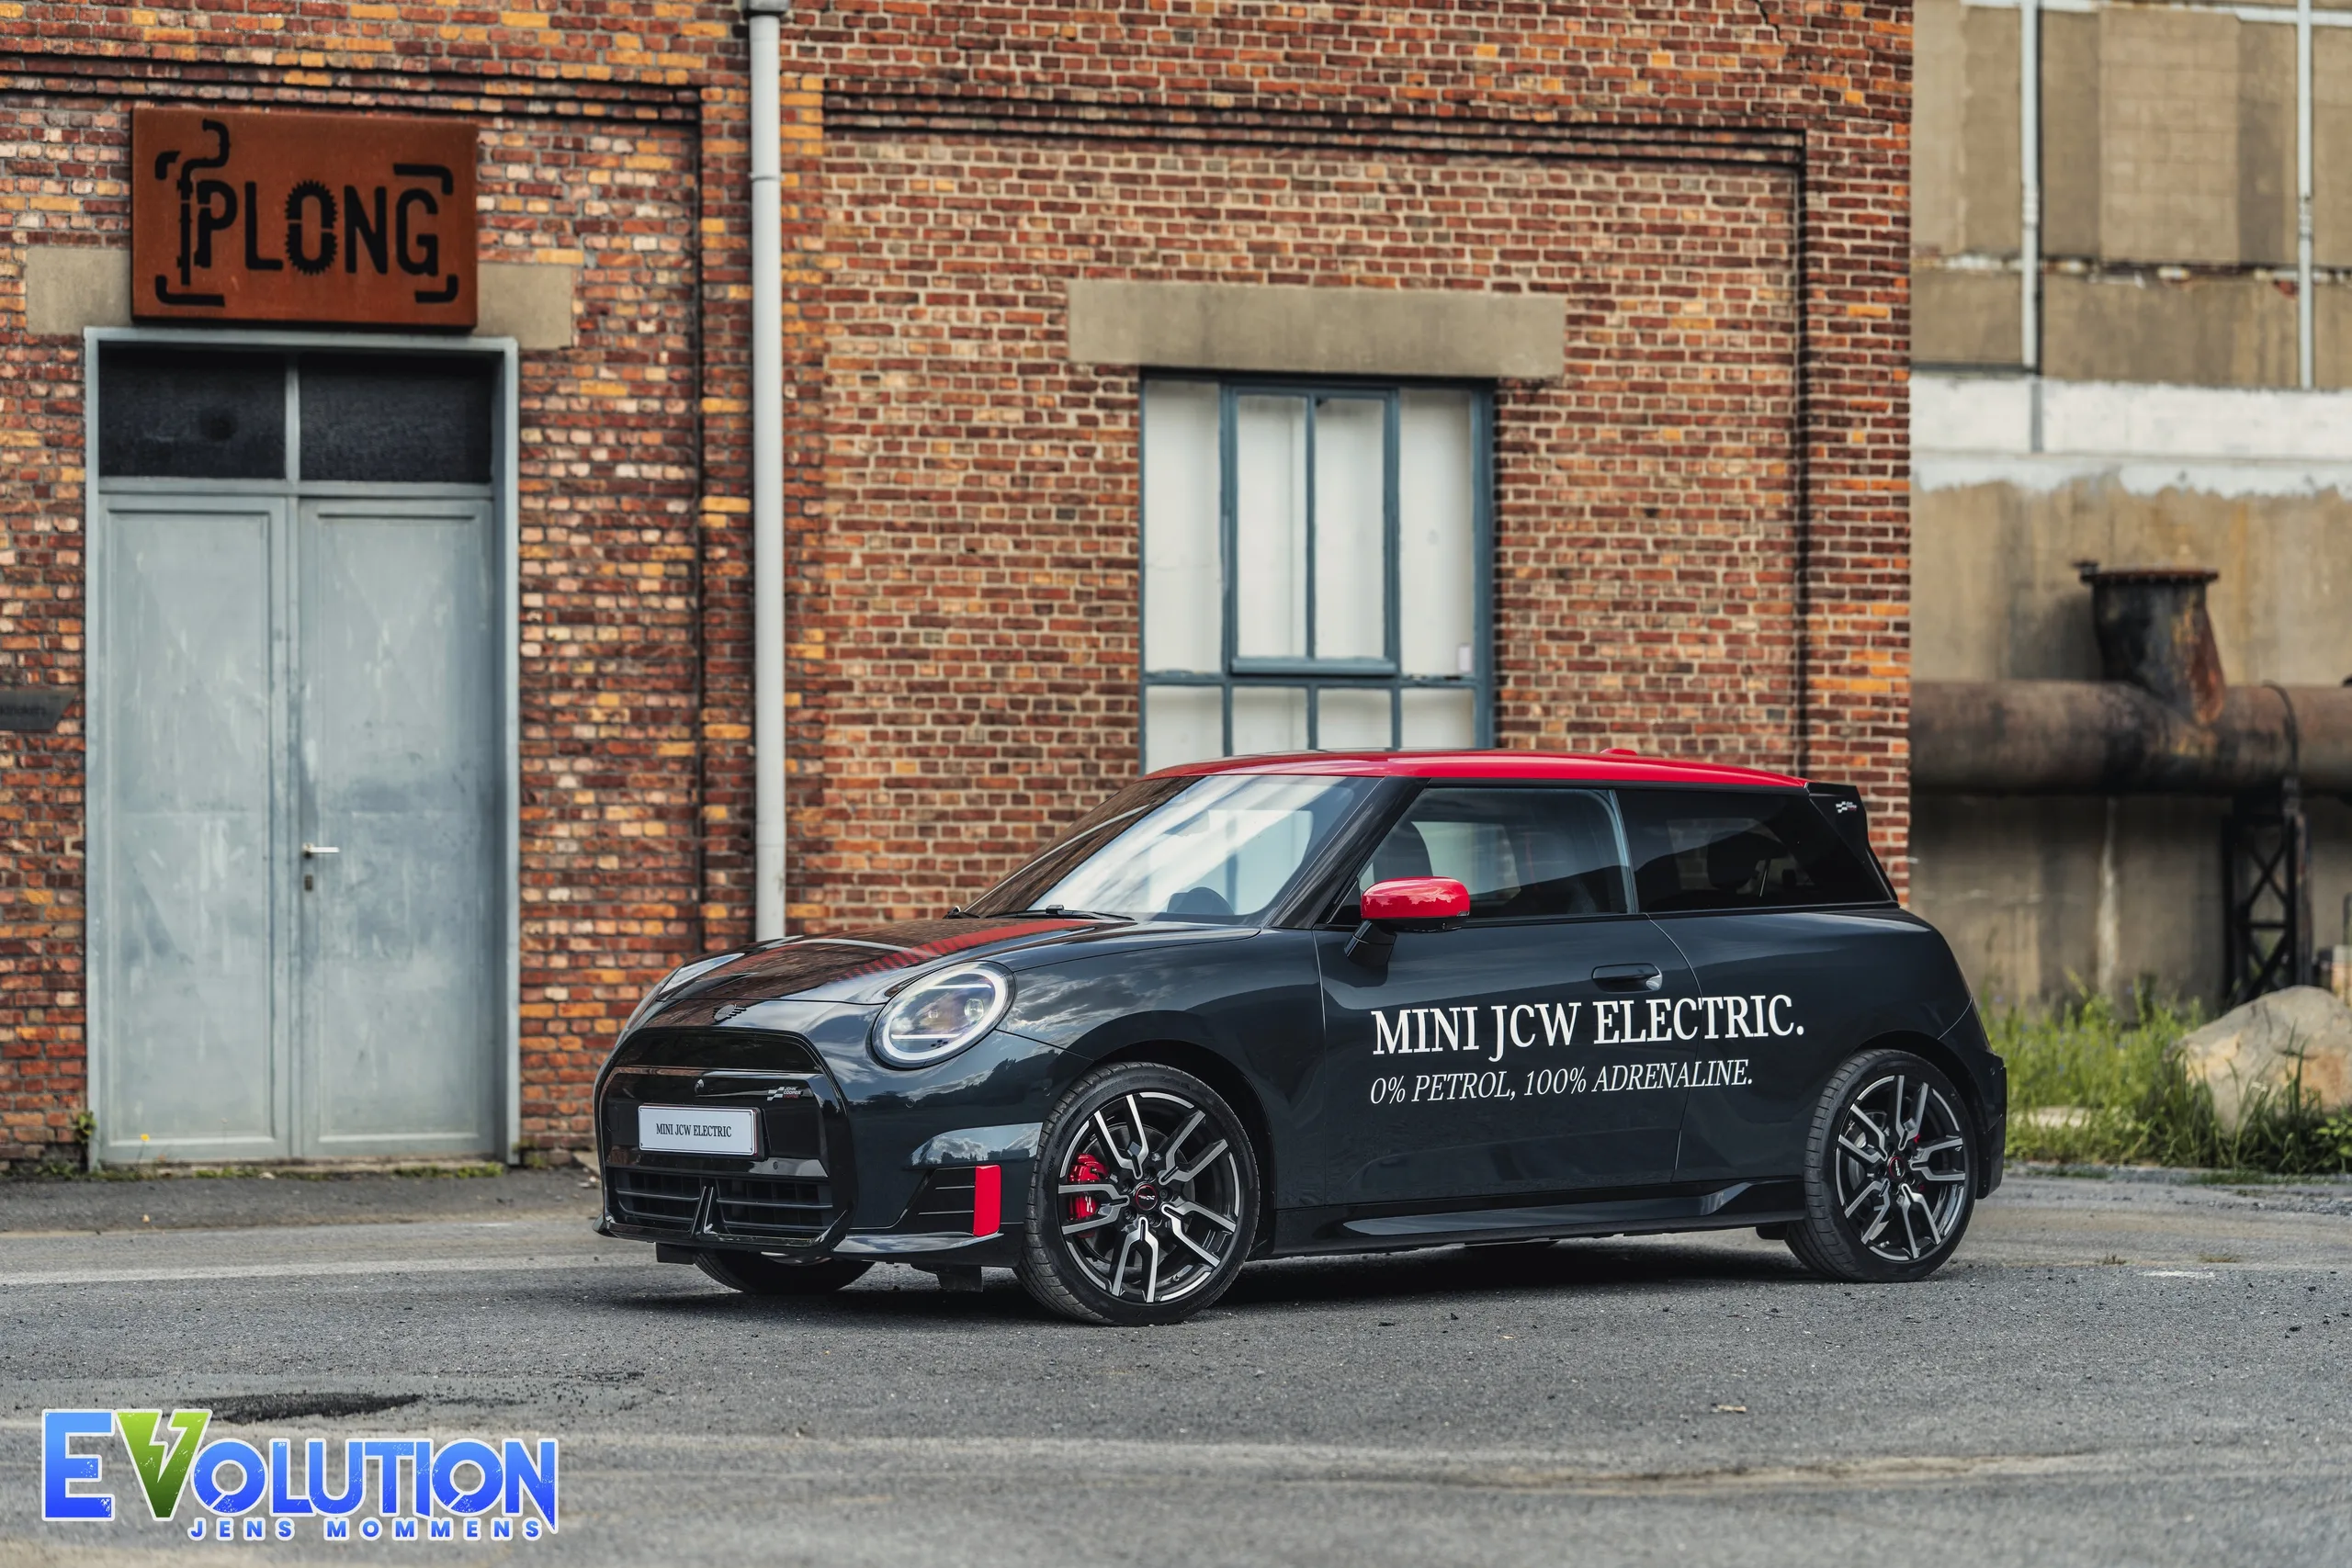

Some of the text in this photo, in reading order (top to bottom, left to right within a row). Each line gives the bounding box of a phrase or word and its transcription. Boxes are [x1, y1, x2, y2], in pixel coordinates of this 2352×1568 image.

[194, 179, 440, 277] PLONG
[1371, 994, 1804, 1063] MINI JCW ELECTRIC.
[1370, 1059, 1753, 1104] 0% PETROL, 100% ADRENALINE.
[655, 1123, 732, 1138] MINI JCW ELECTRIC
